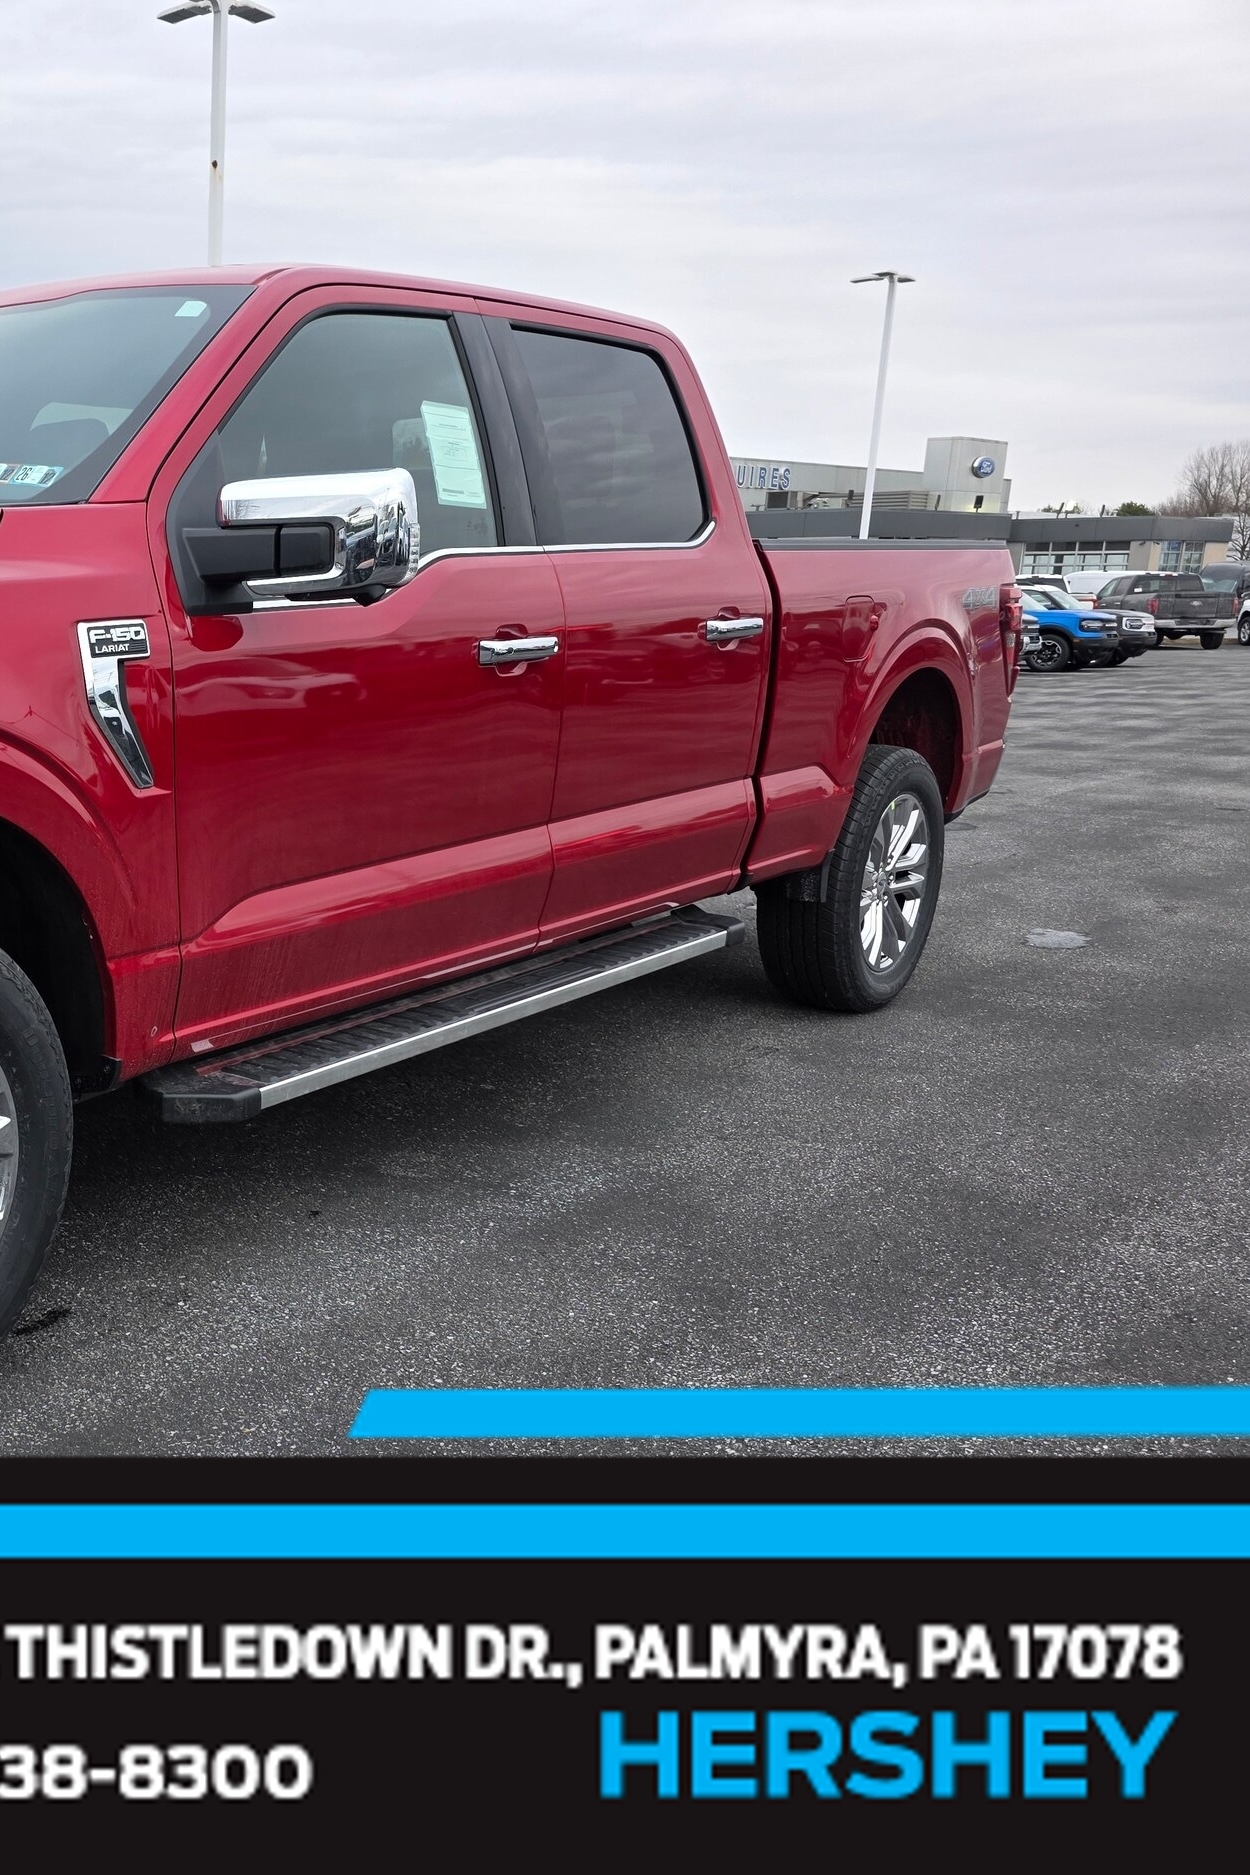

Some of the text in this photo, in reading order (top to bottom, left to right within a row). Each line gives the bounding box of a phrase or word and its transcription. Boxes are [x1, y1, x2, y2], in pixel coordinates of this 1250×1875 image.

[15, 467, 33, 481] 26
[89, 626, 146, 644] F-150
[94, 643, 130, 654] LARIAT
